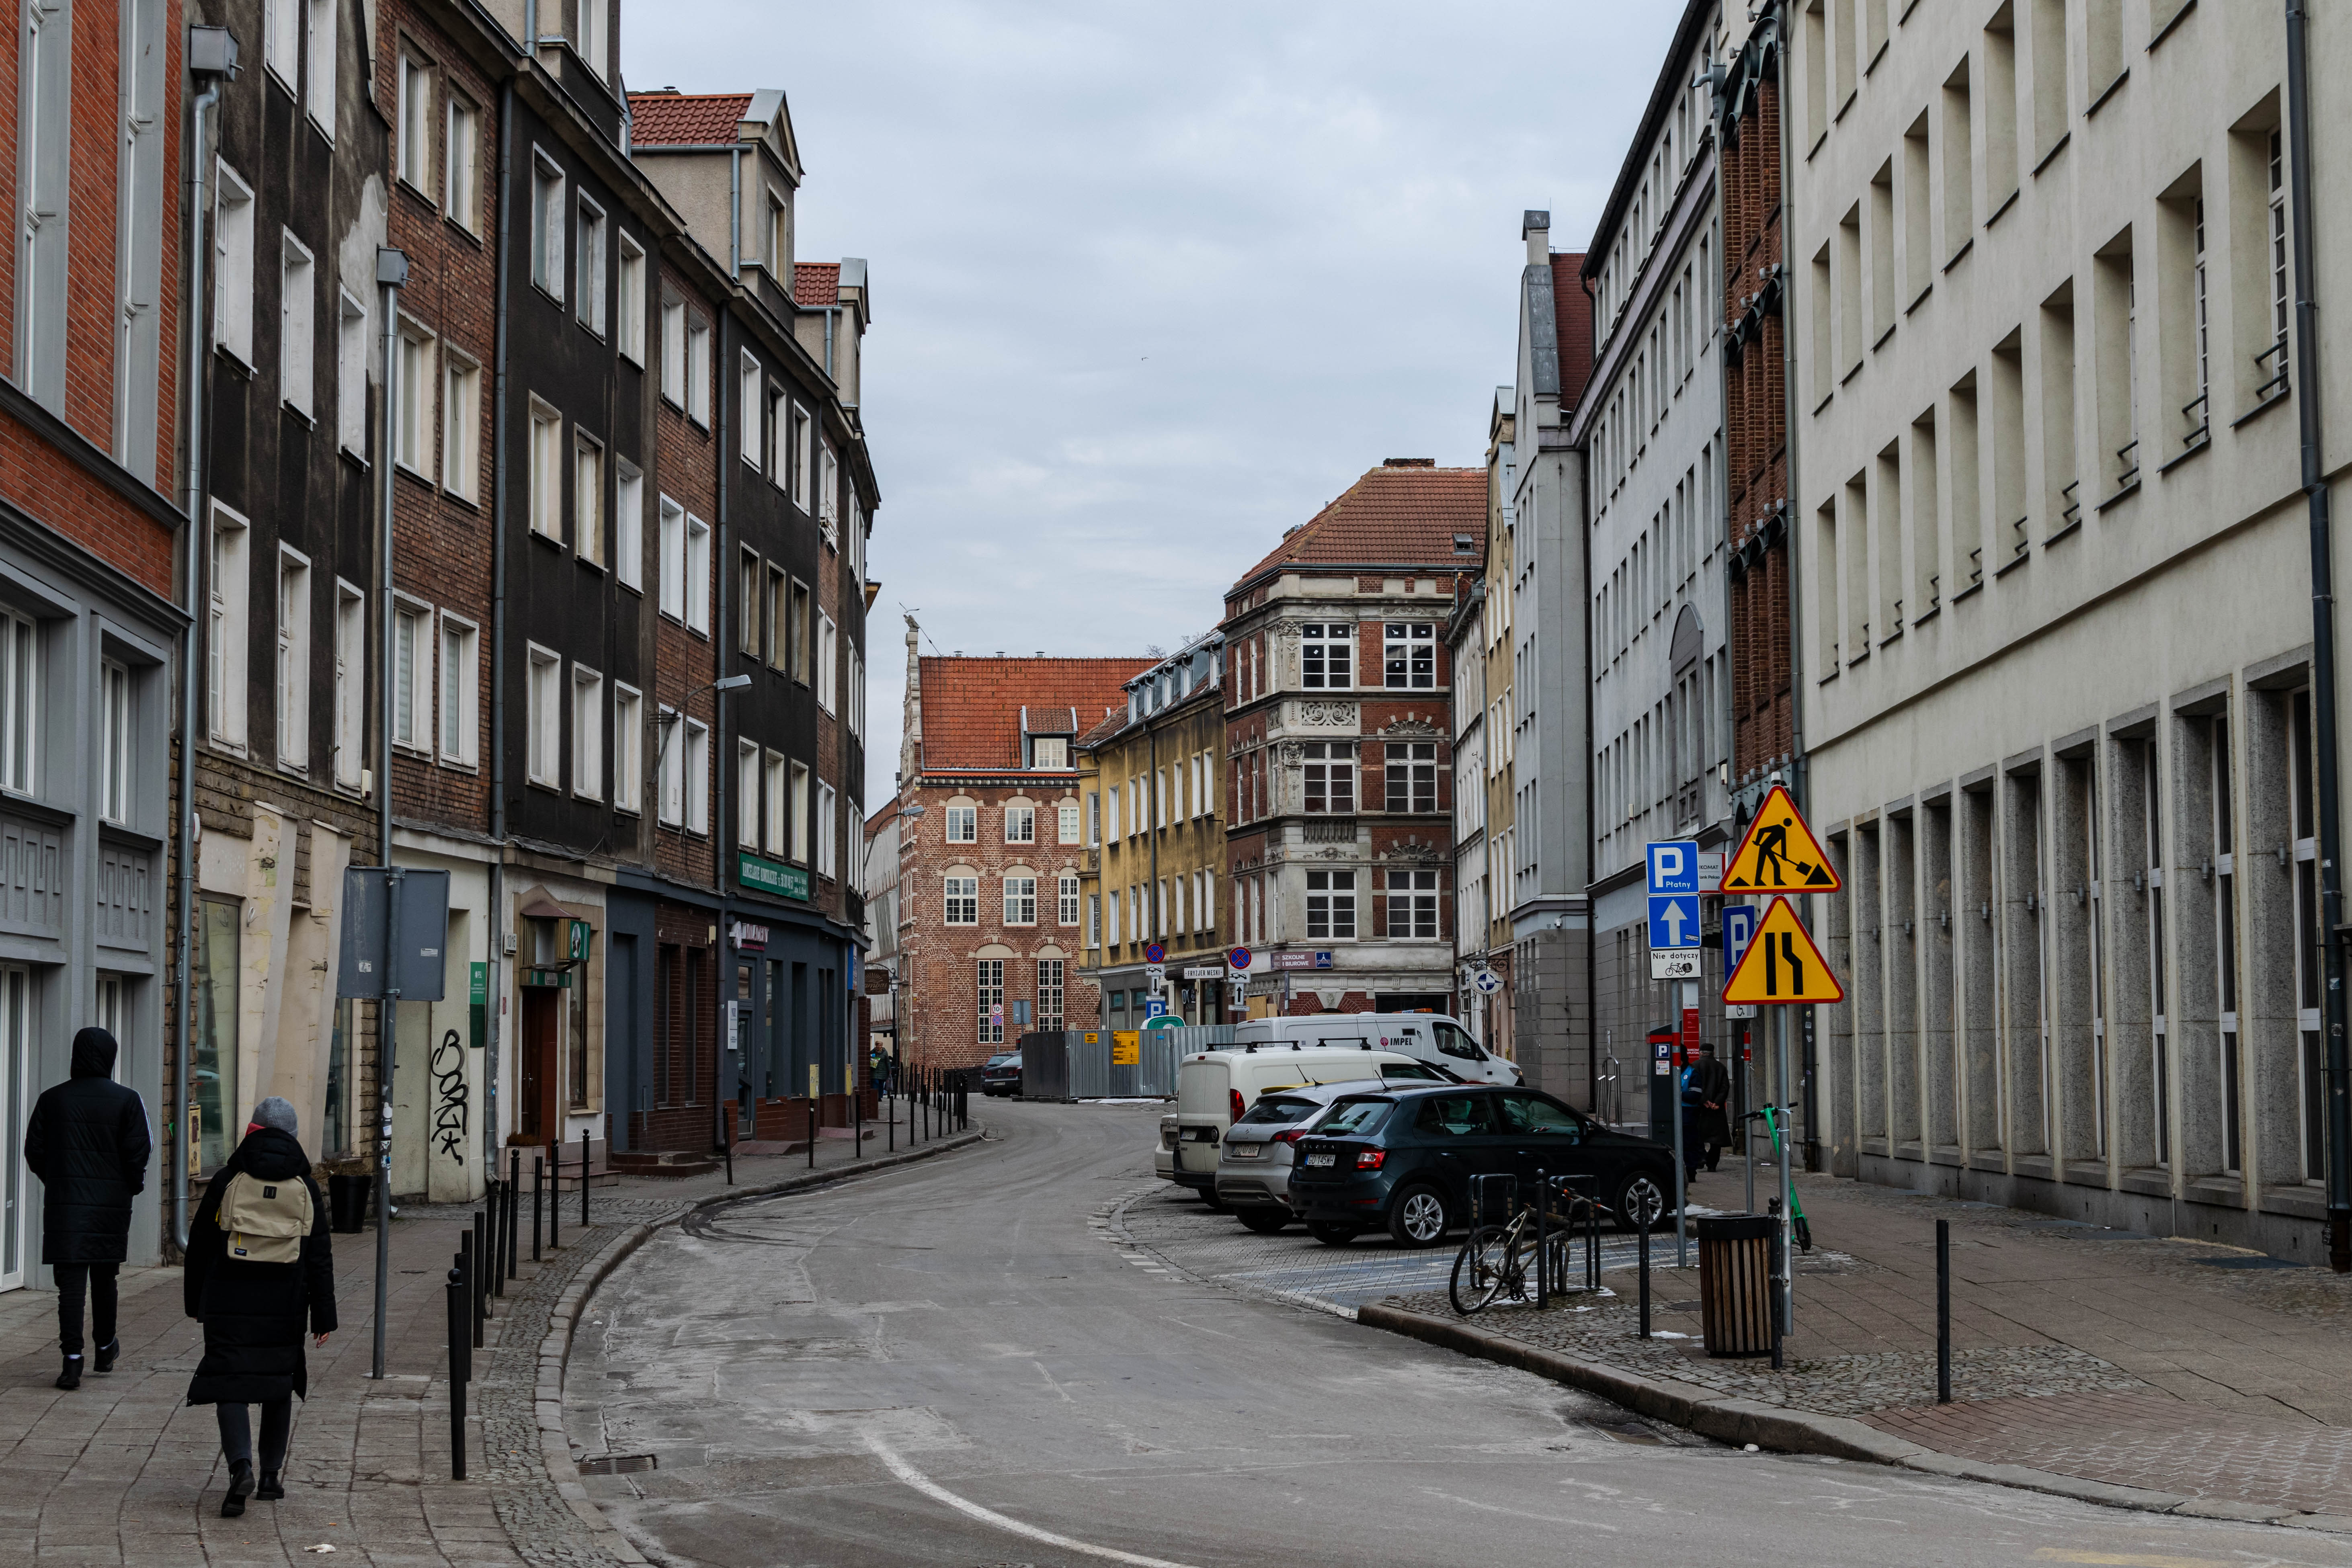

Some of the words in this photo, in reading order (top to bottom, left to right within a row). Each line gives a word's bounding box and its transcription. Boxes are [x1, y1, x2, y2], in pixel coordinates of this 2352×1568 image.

[1654, 847, 1684, 888] P
[1666, 881, 1690, 889] Płatny
[1730, 914, 1748, 965] P
[1670, 952, 1698, 960] dotyczy
[1150, 1003, 1162, 1017] P
[1390, 1037, 1413, 1045] IMPEL
[1658, 1045, 1667, 1057] P
[1235, 1144, 1242, 1154] GD
[1308, 1155, 1316, 1164] GD
[1318, 1155, 1335, 1165] 145WH
